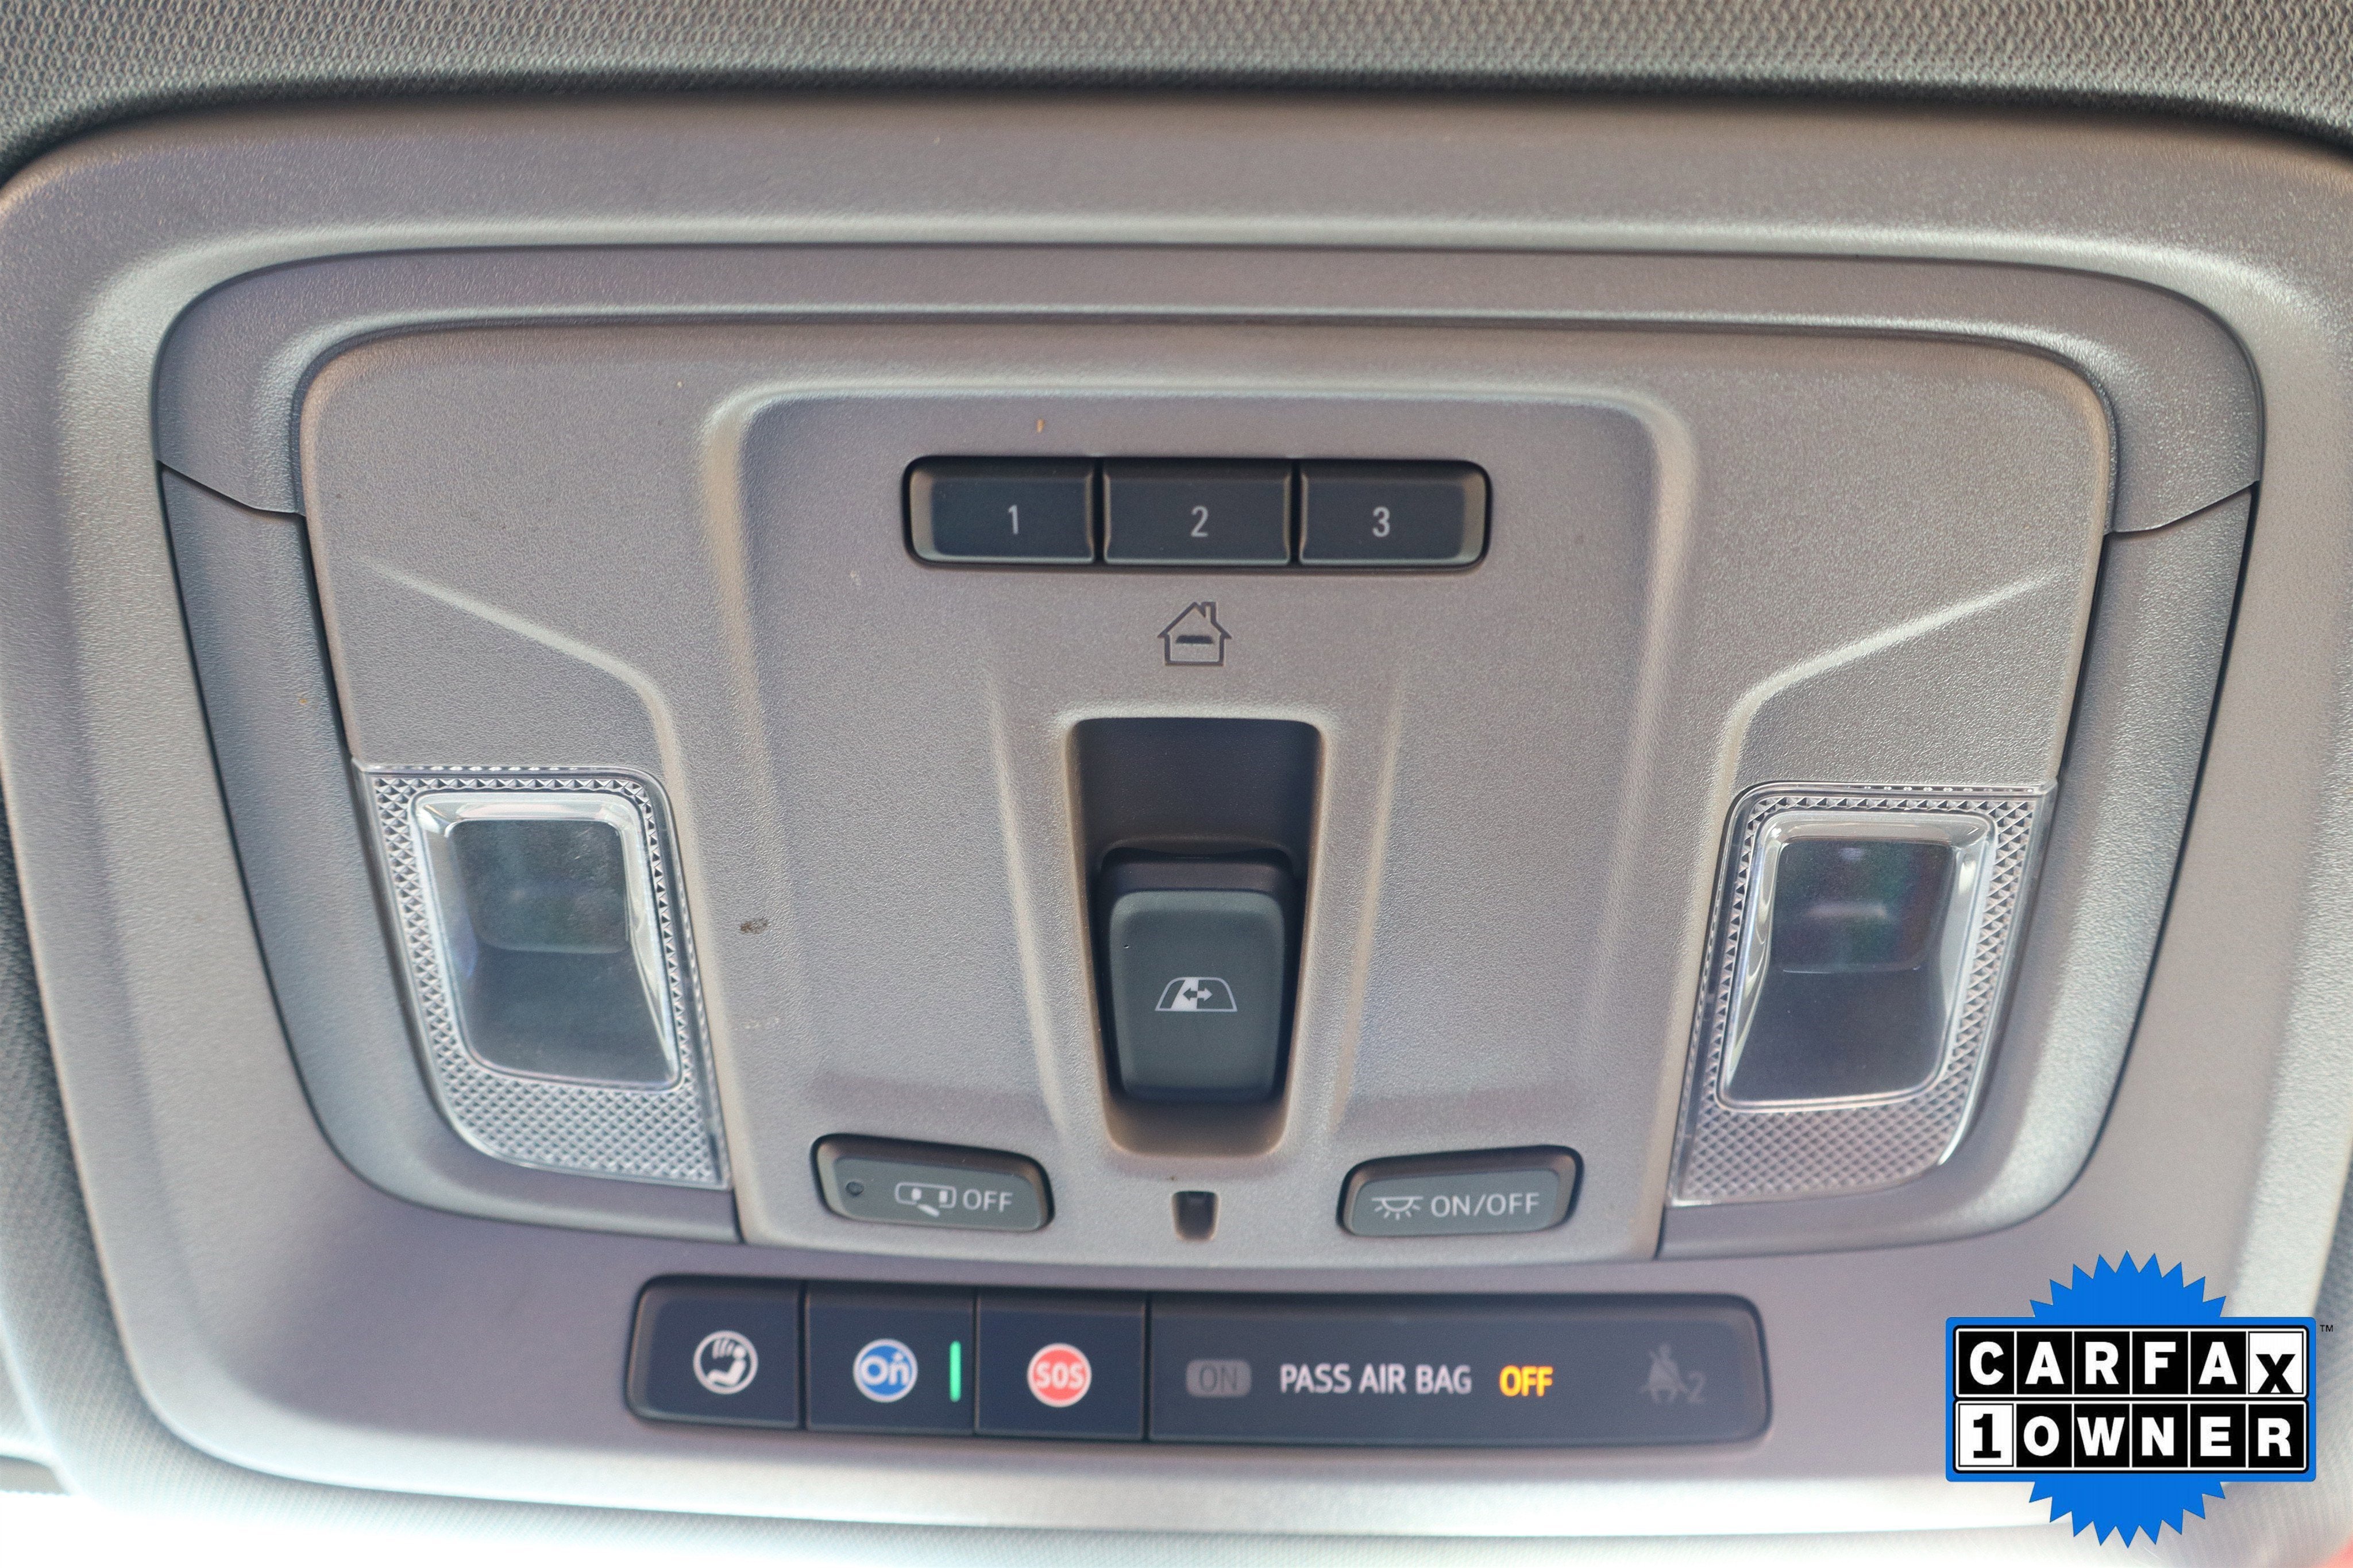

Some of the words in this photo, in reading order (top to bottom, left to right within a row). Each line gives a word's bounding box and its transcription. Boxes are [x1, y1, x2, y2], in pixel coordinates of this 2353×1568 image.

[1007, 504, 1020, 535] 1
[1190, 505, 1209, 538] 2
[1372, 506, 1391, 538] 3
[962, 1187, 1013, 1214] OFF
[1430, 1191, 1540, 1218] ON/OFF
[1033, 1361, 1085, 1390] SOS
[1197, 1365, 1240, 1393] ON
[1280, 1364, 1351, 1394] PASS
[1359, 1364, 1407, 1394] AIR
[1415, 1365, 1472, 1395] BAG
[1499, 1365, 1554, 1397] OFF
